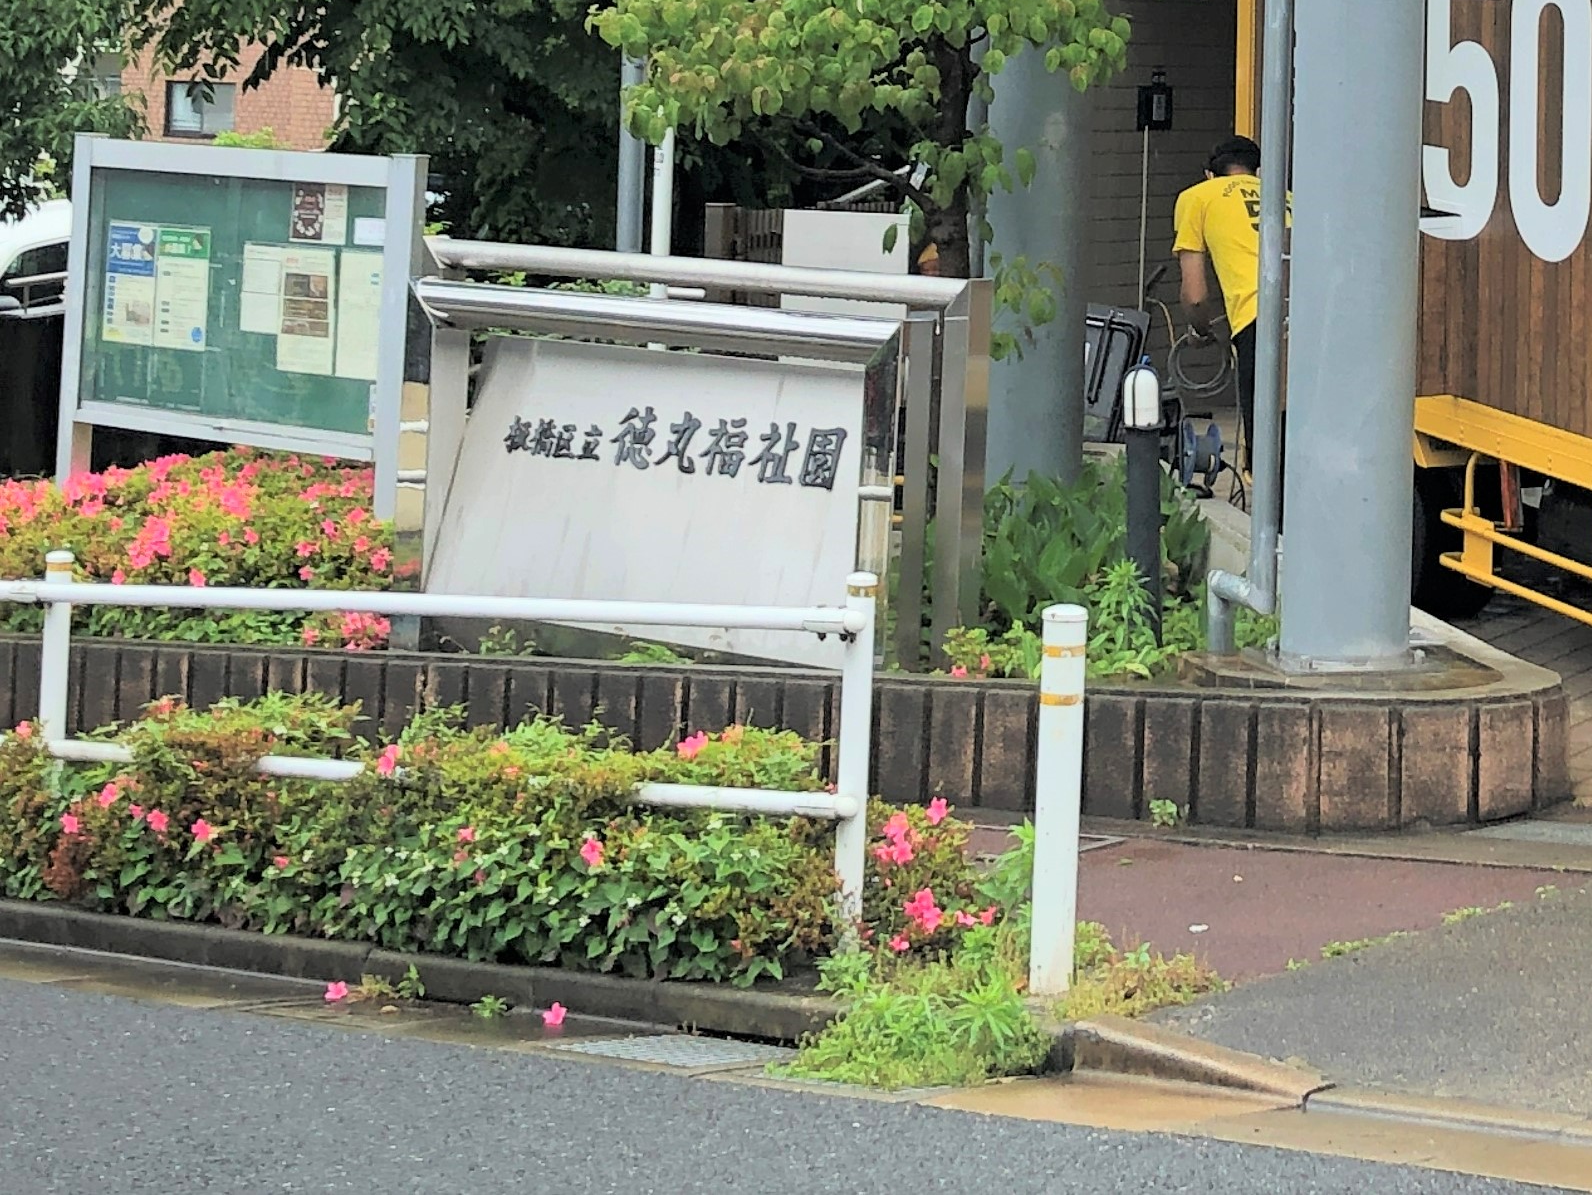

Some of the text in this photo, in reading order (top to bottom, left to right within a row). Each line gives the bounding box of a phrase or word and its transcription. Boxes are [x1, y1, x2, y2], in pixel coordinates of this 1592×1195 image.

[503, 405, 847, 492] 板橋区立 徳丸福祉園
